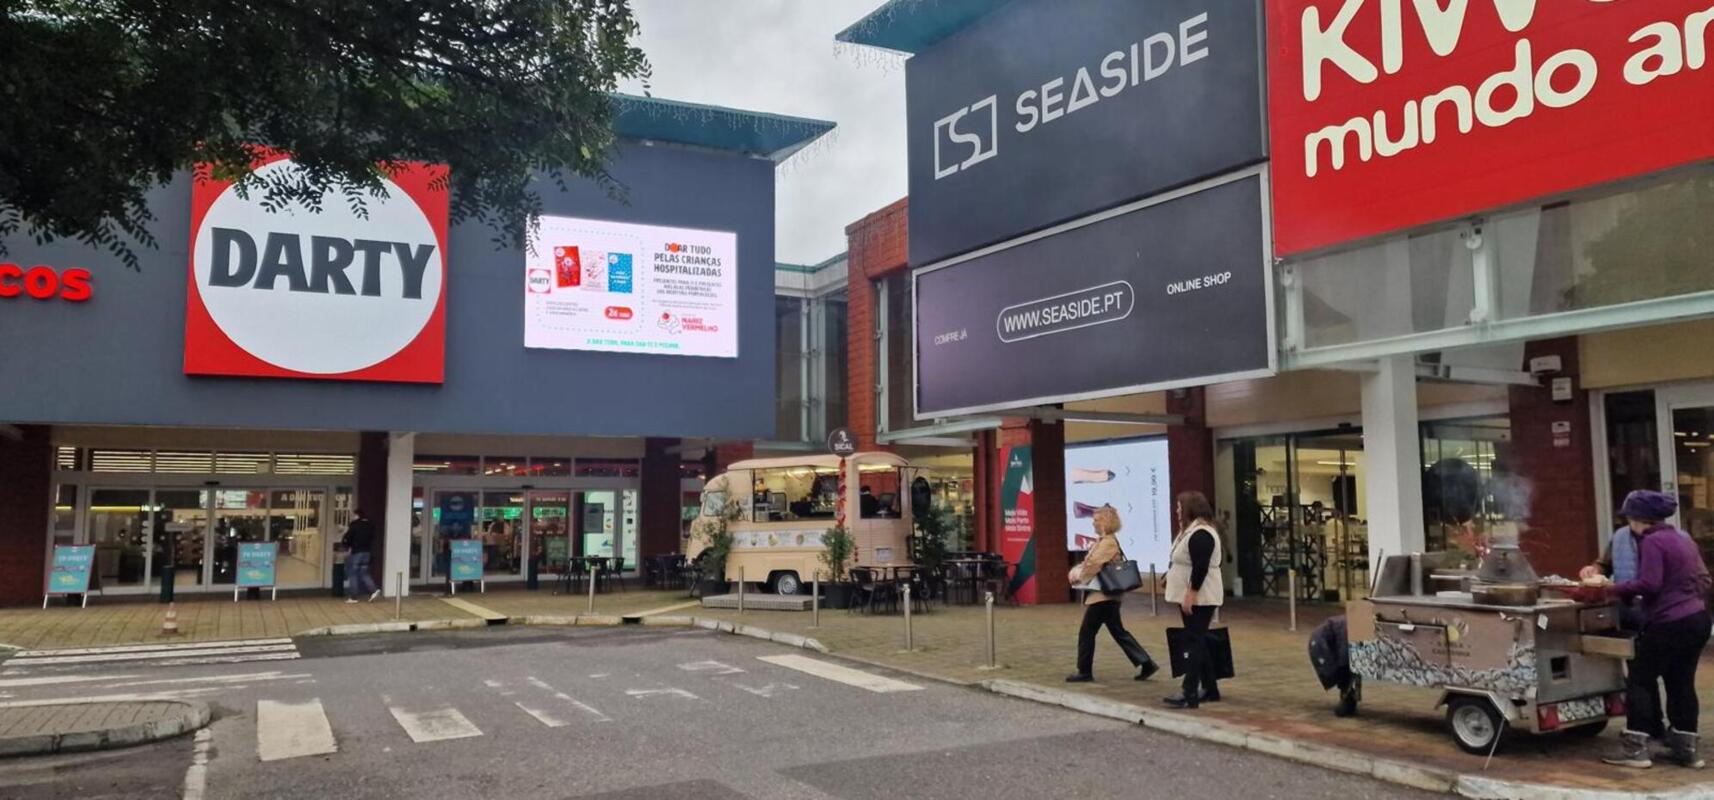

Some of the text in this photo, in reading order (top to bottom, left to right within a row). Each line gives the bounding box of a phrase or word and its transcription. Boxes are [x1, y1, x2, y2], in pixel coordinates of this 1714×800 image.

[1015, 11, 1209, 133] SEASIDE
[1304, 38, 1598, 178] mundo
[654, 253, 722, 267] PELAS CRIANÇAS
[690, 245, 712, 255] TUDO
[208, 226, 436, 300] DARTY
[654, 264, 722, 277] HOSPITALIZADAS
[1167, 271, 1232, 295] ONLINE SHOP
[1004, 291, 1123, 333] WWW.SEASIDE.PT
[934, 331, 959, 346] COMPRE
